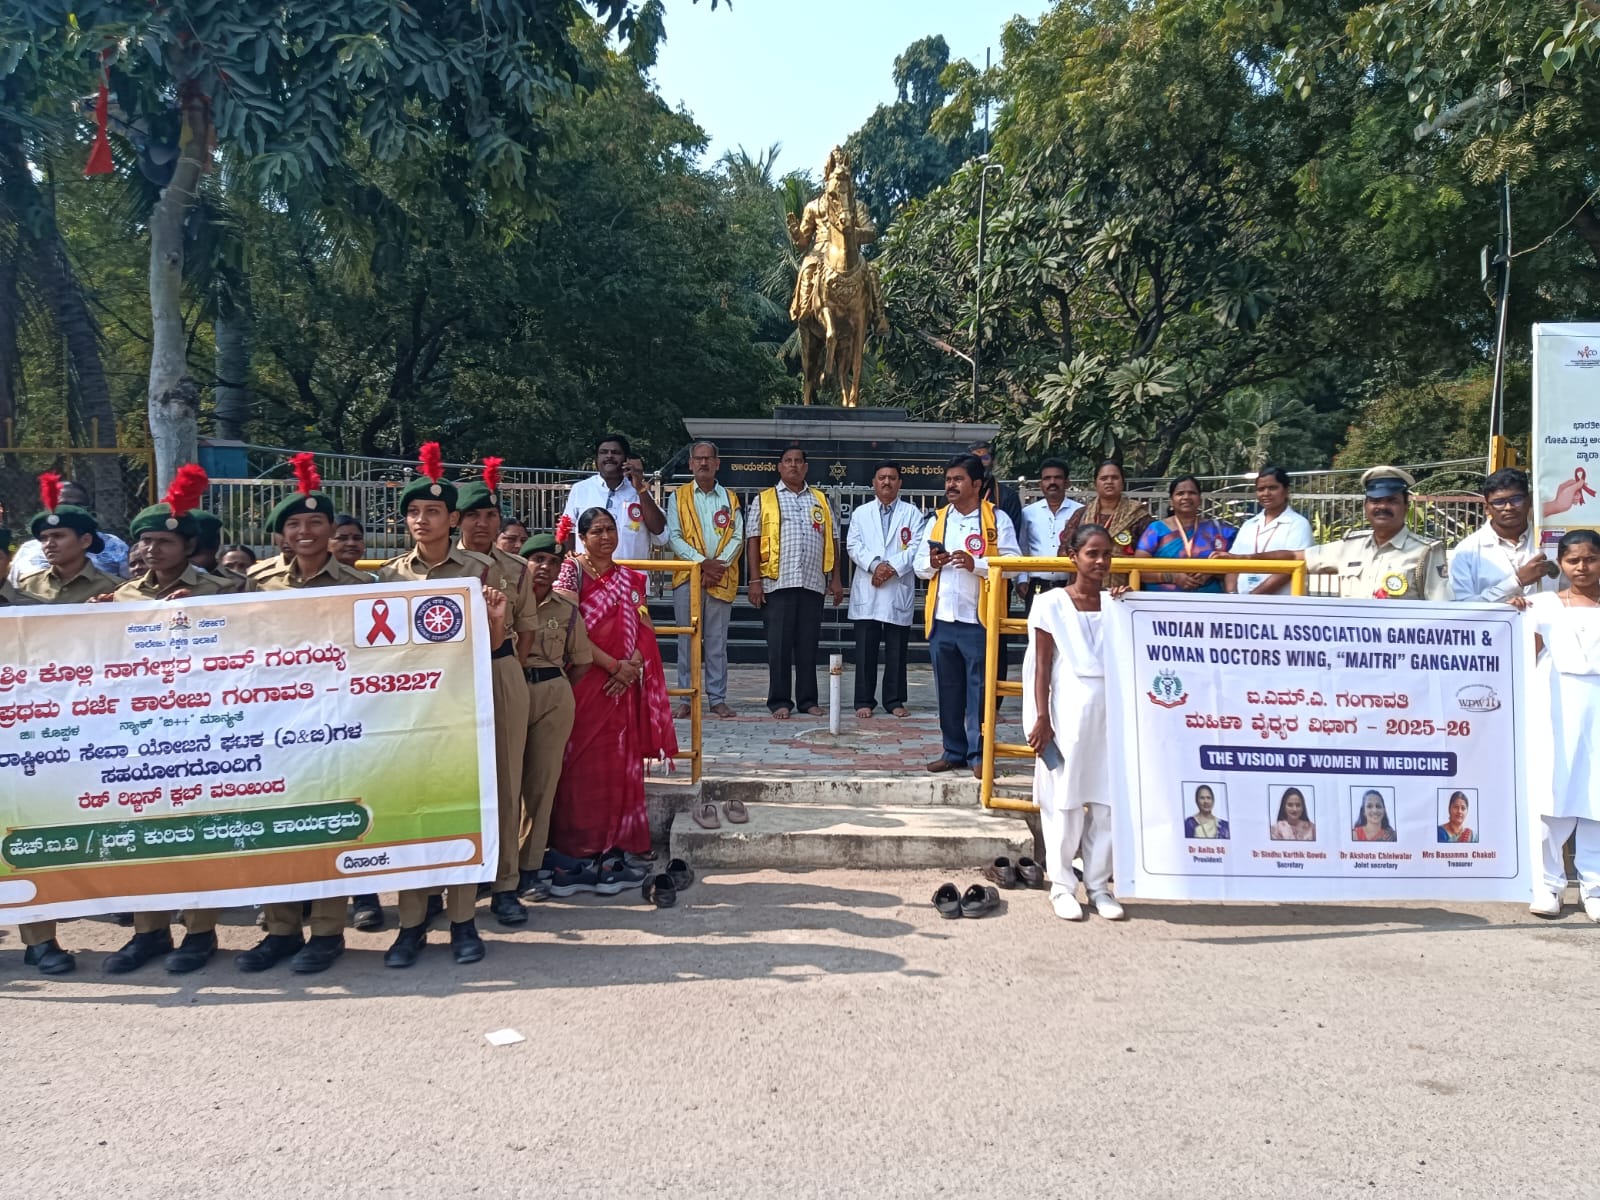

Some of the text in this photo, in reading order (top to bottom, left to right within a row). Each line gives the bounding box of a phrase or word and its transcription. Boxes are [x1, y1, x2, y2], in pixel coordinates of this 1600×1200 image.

[1152, 620, 1493, 647] INDIAN MEDICAL ASSOCIATION GANGAVATHI &
[0, 643, 347, 692] ಶ್ರೀ ಕೊಲ್ಲಿ ನಾಗೇಶ್ವರ ರಾವ್ ಗಂಗಯ್ಯ
[1146, 644, 1205, 663] WOMAN
[1210, 647, 1281, 666] DOCTORS
[1286, 650, 1332, 671] WING,
[1411, 653, 1500, 673] GANGAVATHI
[0, 699, 61, 728] ಪ್ರಥಮ
[72, 695, 121, 717] ದರ್ಜೆ
[131, 689, 211, 713] ಕಾಲೇಜು
[222, 681, 314, 706] ಗಂಗಾವತಿ
[349, 671, 442, 695] 583227
[1336, 690, 1410, 709] ಗಂಗಾವತಿ
[200, 711, 244, 729] ಮಾನ್ಯತೆ
[1185, 712, 1242, 730] ಮಹಿಳಾ
[1308, 716, 1358, 735] ವಿಭಾಗ
[1386, 718, 1471, 737] 2025-26
[0, 746, 71, 776] ರಾಷ್ಟ್ರೀಯ
[80, 743, 129, 762] ಸೇವಾ
[139, 734, 211, 757] ಯೋಜನೆ
[220, 730, 264, 752] ಘಟಕ
[1207, 751, 1449, 772] THE VISION OF WOMEN IN MEDICINE
[101, 754, 262, 783] ಸಹಯೋಗದೊಂದಿಗೆ
[79, 777, 285, 813] ರೆಡ್ ರಿಬ್ಬನ್ ಕ್ಲಬ್ ವತಿಯಿಂದ
[144, 826, 195, 844] ಕುರಿತು
[203, 820, 264, 842] ತರಬೇತಿ
[273, 811, 361, 835] ಕಾರ್ಯಕ್ರಮ
[343, 852, 390, 869] ದಿನಾಂಕ:
